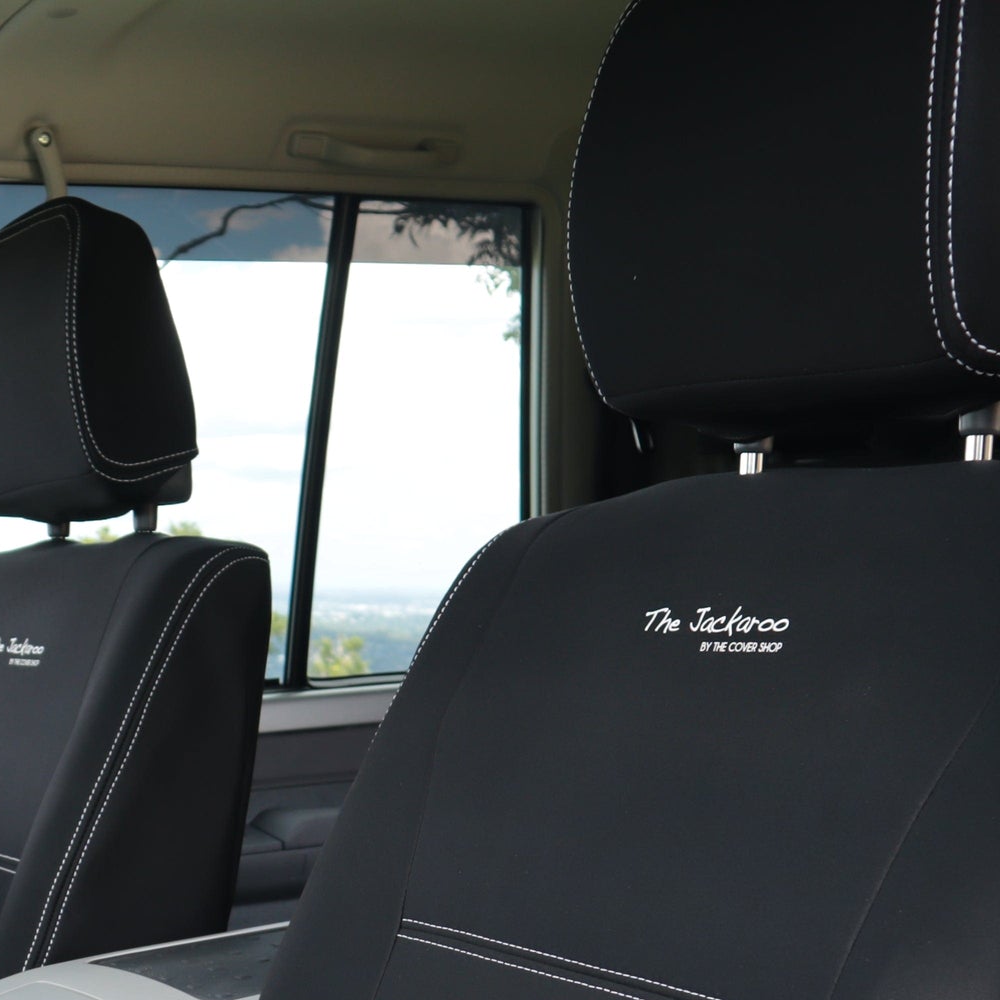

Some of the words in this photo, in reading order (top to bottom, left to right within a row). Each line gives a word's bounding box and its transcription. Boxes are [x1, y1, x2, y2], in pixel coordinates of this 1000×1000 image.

[644, 607, 681, 634] The
[689, 605, 790, 637] Jackaroo
[6, 637, 45, 656] Jackaroo
[699, 641, 713, 652] BY
[712, 641, 729, 652] THE
[728, 641, 758, 653] COVER
[758, 642, 783, 653] SHOP
